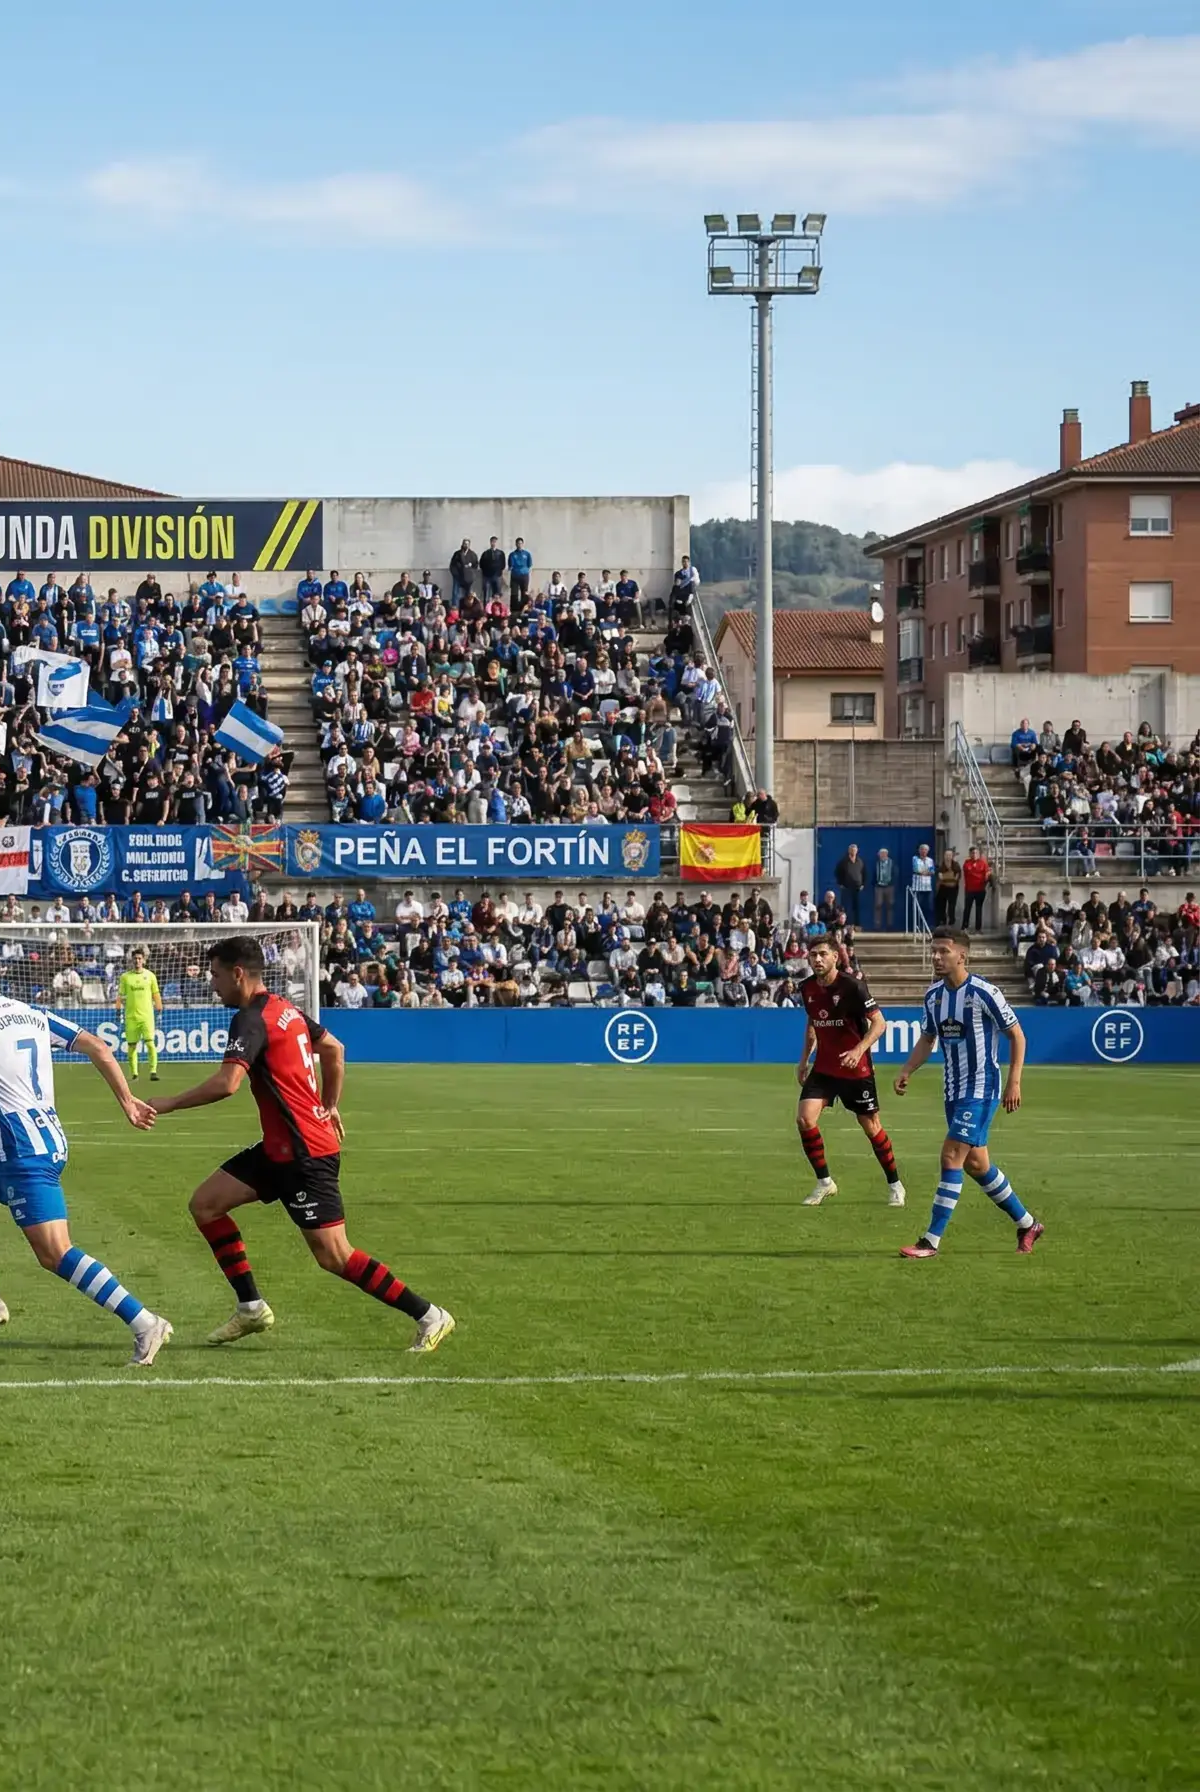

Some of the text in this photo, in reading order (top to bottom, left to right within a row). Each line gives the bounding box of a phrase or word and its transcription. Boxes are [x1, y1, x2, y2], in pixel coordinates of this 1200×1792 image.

[89, 505, 234, 560] DIVISIÓN
[333, 830, 609, 866] PEÑA EL FORTÍN
[15, 1037, 43, 1101] 7
[297, 1033, 317, 1094] 5
